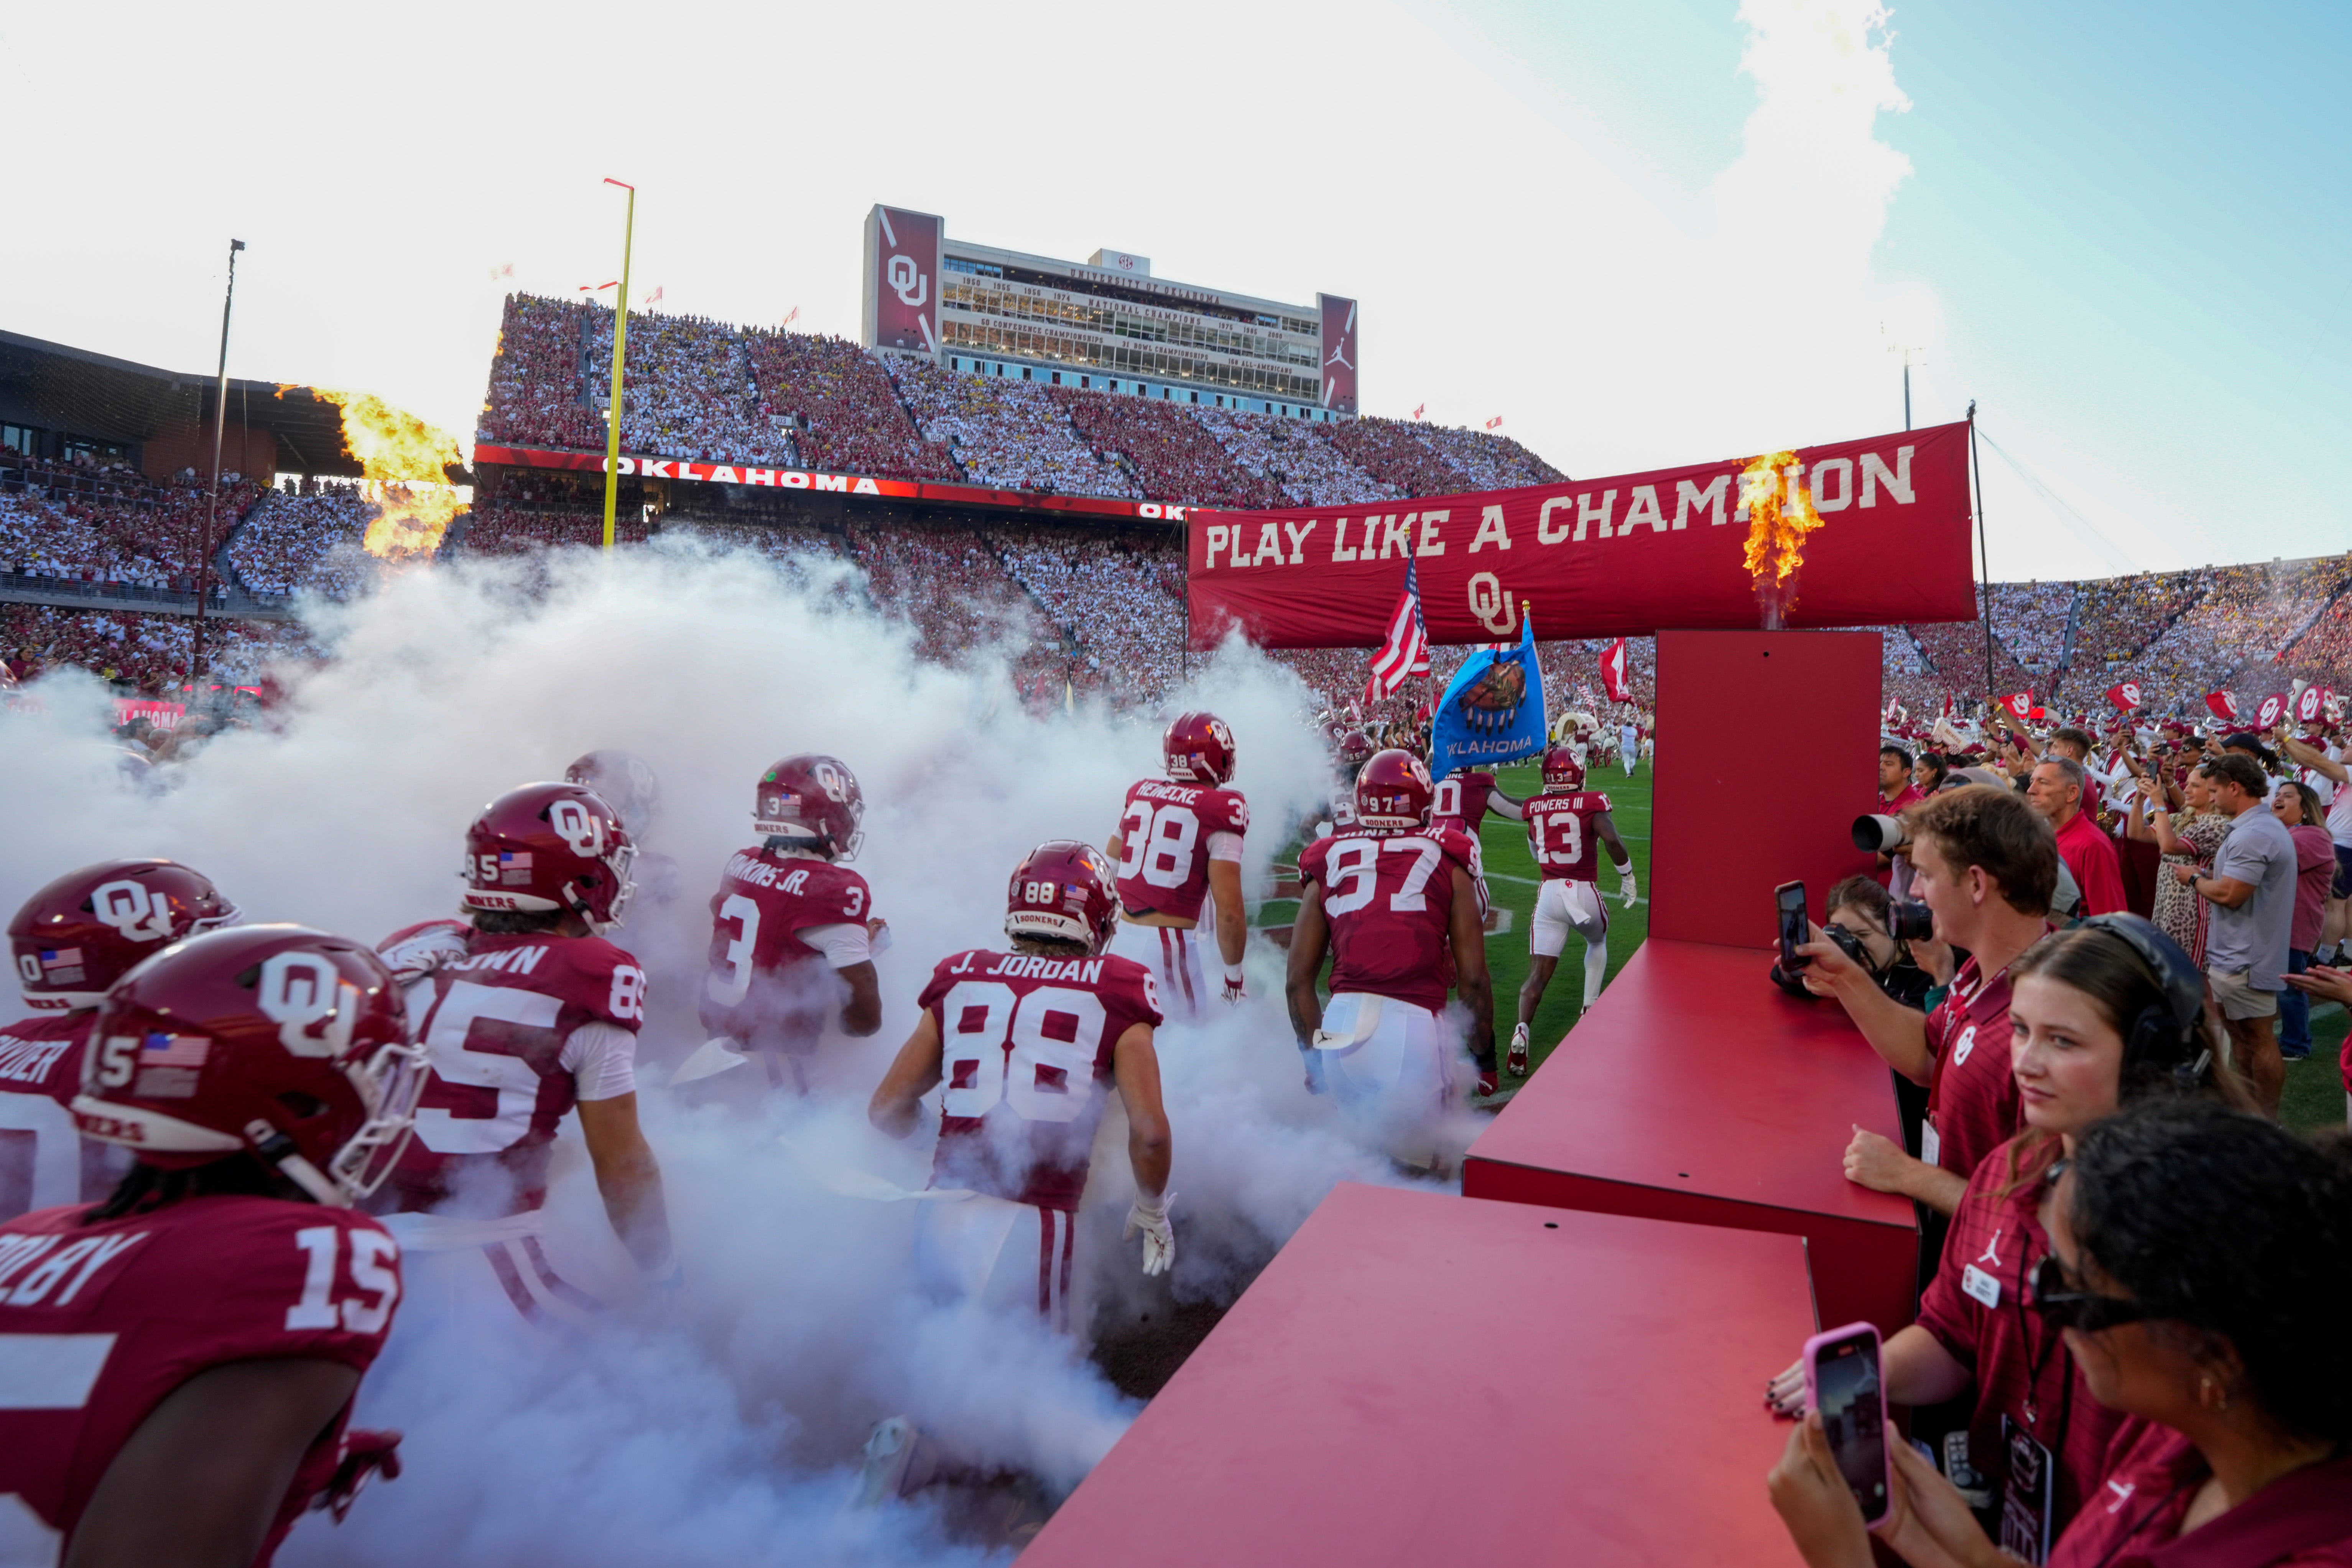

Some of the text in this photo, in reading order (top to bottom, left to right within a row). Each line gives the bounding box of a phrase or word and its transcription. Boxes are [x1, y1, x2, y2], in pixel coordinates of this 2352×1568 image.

[1120, 255, 1132, 270] SEC
[888, 254, 927, 307] OU
[1071, 269, 1219, 304] UNIVERSITY OF OKLAHOMA
[963, 277, 980, 286] 1950
[993, 283, 1011, 291] 1955
[1024, 288, 1041, 296] 1956
[1054, 293, 1070, 301] 1974
[1089, 299, 1139, 314] NATIONAL
[1146, 309, 1201, 325] CHAMPIONS
[993, 321, 1041, 334] CONFERENCE
[1045, 328, 1103, 344] CHAMPIONSHIPS
[1134, 343, 1153, 351] BOWL
[1155, 347, 1208, 360] CHAMPIONSHIPS
[1242, 360, 1292, 374] ALL-AMERICANS
[595, 398, 610, 406] 101-1
[602, 457, 880, 495] OKLAHOMA
[1139, 503, 1198, 521] OK
[1206, 520, 1316, 569] PLAY
[1332, 510, 1451, 562] LIKE
[1469, 504, 1512, 554] A
[1467, 572, 1517, 635] OU
[2260, 697, 2280, 726] OU
[2301, 689, 2319, 720] OU
[1171, 754, 1188, 768] 38
[1349, 752, 1360, 761] 65
[1447, 735, 1531, 757] KLAHOMA
[815, 763, 848, 802] OU
[1136, 781, 1203, 805] HEINECKE
[1550, 773, 1563, 782] 13
[768, 797, 780, 815] 3
[1369, 797, 1393, 812] 97
[1530, 797, 1583, 814] POWERS III
[550, 800, 603, 857] OU
[1533, 812, 1582, 864] 13
[1117, 800, 1199, 889] 38
[466, 854, 498, 881] 85
[775, 869, 809, 896] JR.
[1324, 837, 1441, 919] 97
[843, 886, 863, 916] 3
[1025, 882, 1054, 904] 88
[91, 879, 173, 942] OU
[1020, 915, 1058, 925] SOONERS
[441, 945, 549, 975] OWN
[707, 893, 761, 1008] 3
[951, 952, 1104, 984] J. JORDAN
[258, 951, 361, 1058] OU
[942, 981, 1107, 1123] 88
[285, 1227, 402, 1334] 15
